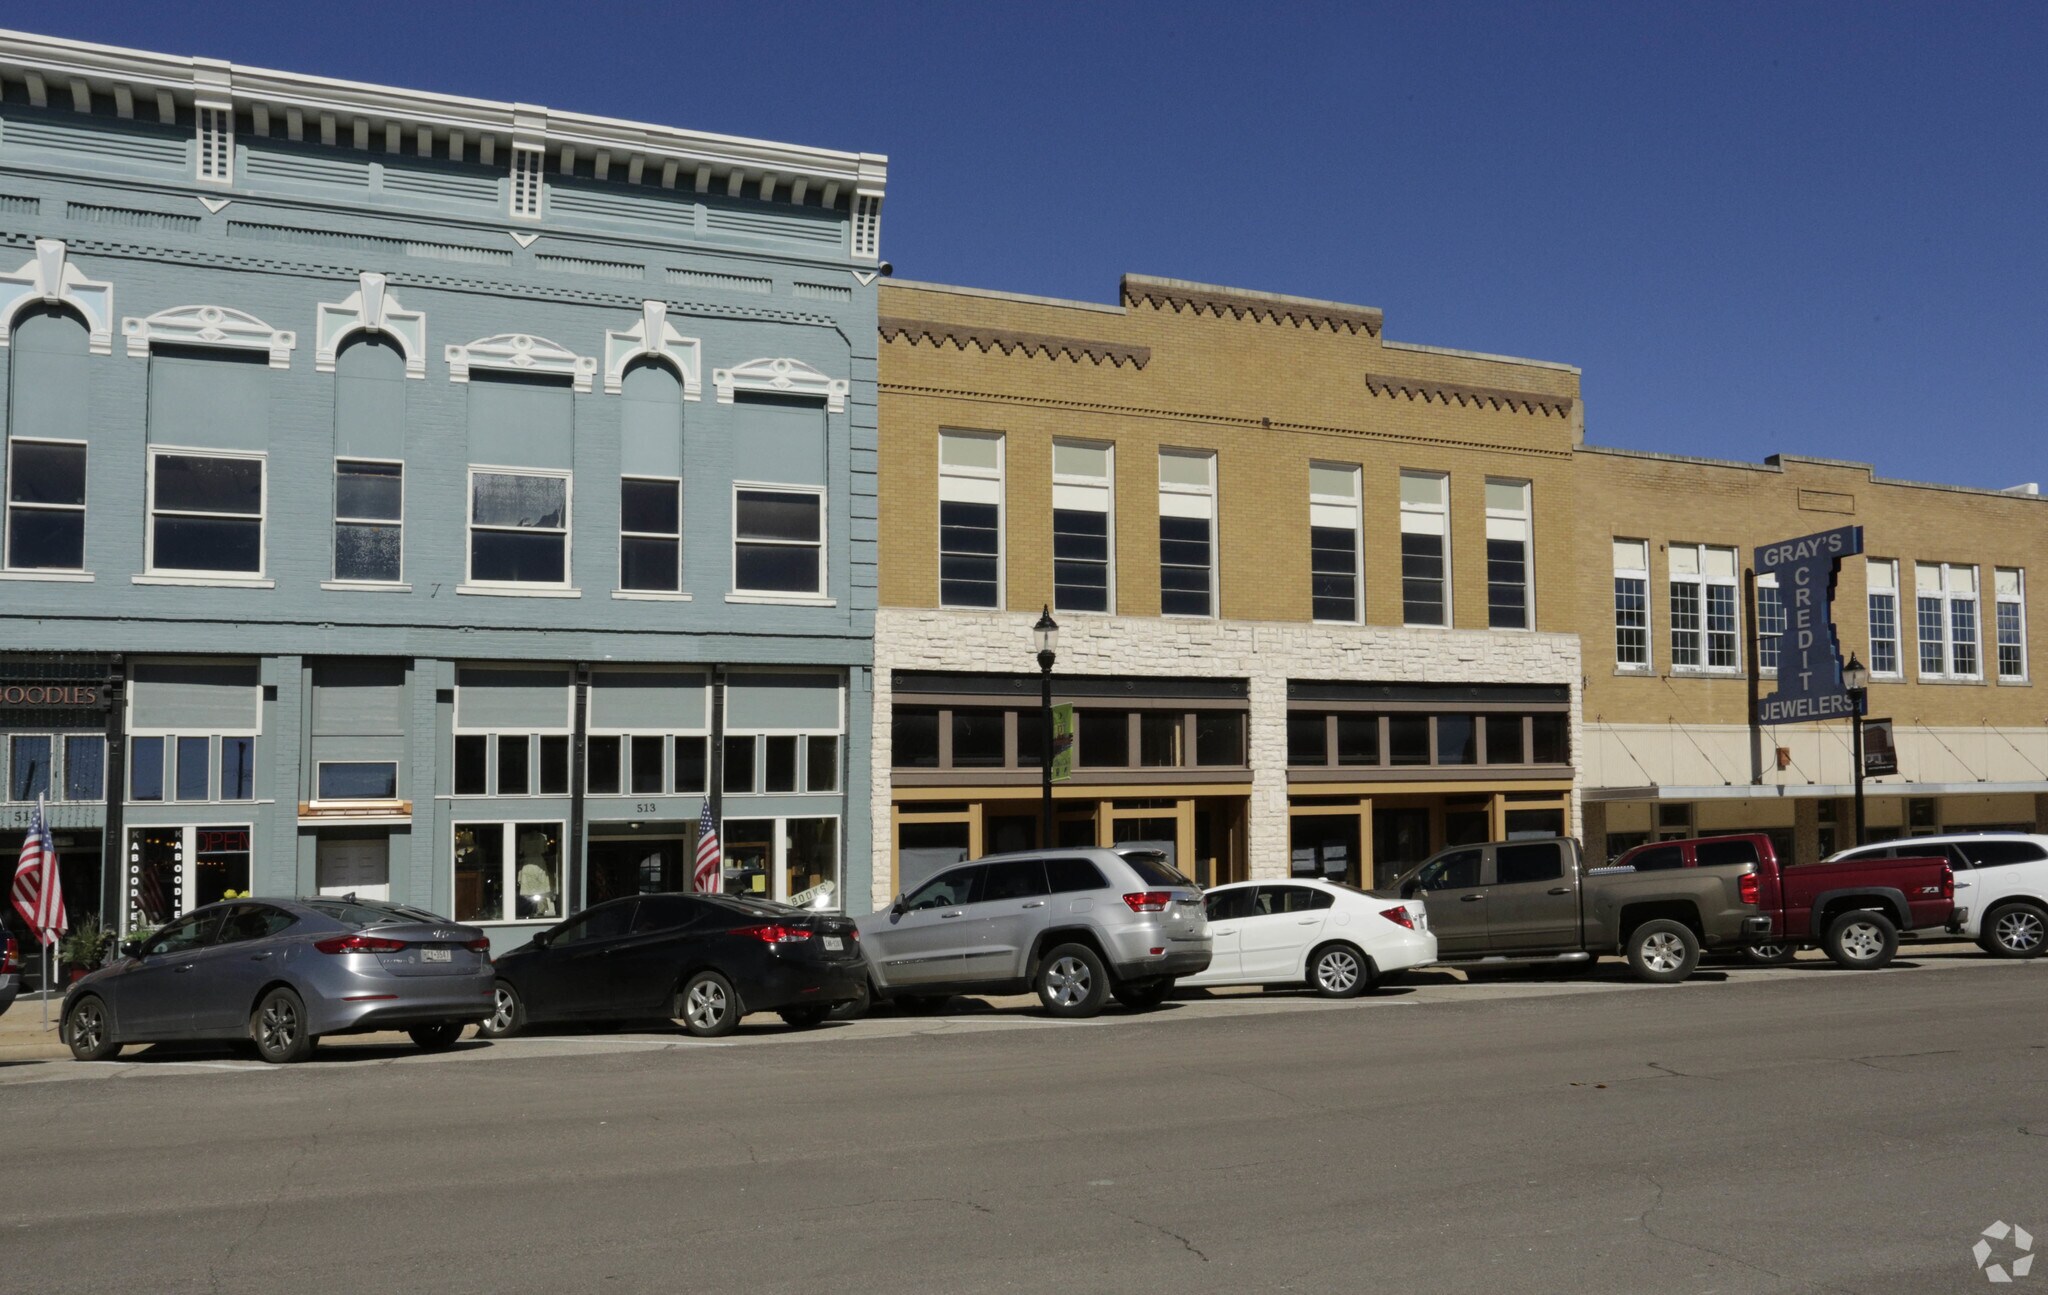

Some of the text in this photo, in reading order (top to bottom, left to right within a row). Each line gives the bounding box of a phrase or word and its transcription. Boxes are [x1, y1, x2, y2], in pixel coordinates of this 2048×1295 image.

[1764, 533, 1842, 567] GRAY'S
[1795, 566, 1813, 691] CREDIT
[0, 686, 96, 705] OODLES
[1761, 694, 1854, 721] JEWELERS
[14, 811, 32, 821] 51
[637, 803, 656, 813] 513
[196, 831, 250, 852] OPEN
[130, 831, 139, 931] KABOODLES
[174, 830, 183, 919] KABOODLE
[791, 884, 827, 906] BOOKS
